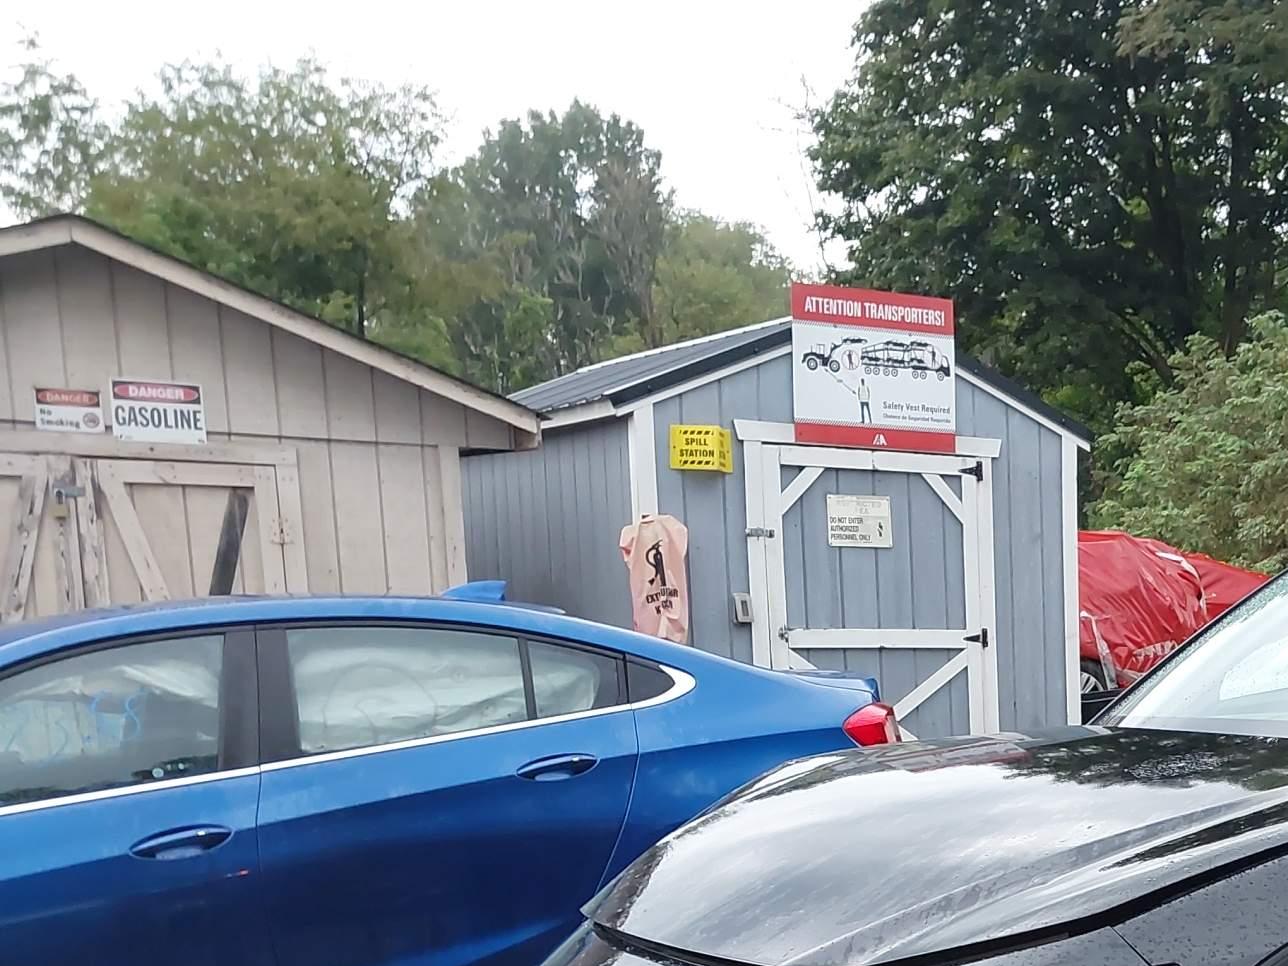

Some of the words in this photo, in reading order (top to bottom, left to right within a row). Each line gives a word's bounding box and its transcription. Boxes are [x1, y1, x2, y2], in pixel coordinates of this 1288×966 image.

[804, 296, 861, 317] ATTENTION
[863, 303, 944, 326] TRANSPORTERS!
[47, 392, 89, 404] DANGER
[128, 385, 184, 401] DANGER
[40, 408, 52, 416] No
[883, 401, 904, 411] Safety
[905, 403, 920, 411] Vest
[921, 404, 951, 415] Required
[40, 417, 80, 429] Smoking
[114, 405, 203, 431] GASOLINE
[684, 437, 709, 446] SPILL
[679, 449, 714, 458] STATION
[830, 516, 837, 524] DO
[848, 517, 863, 525] ENTER
[830, 533, 858, 541] PERSONNEL
